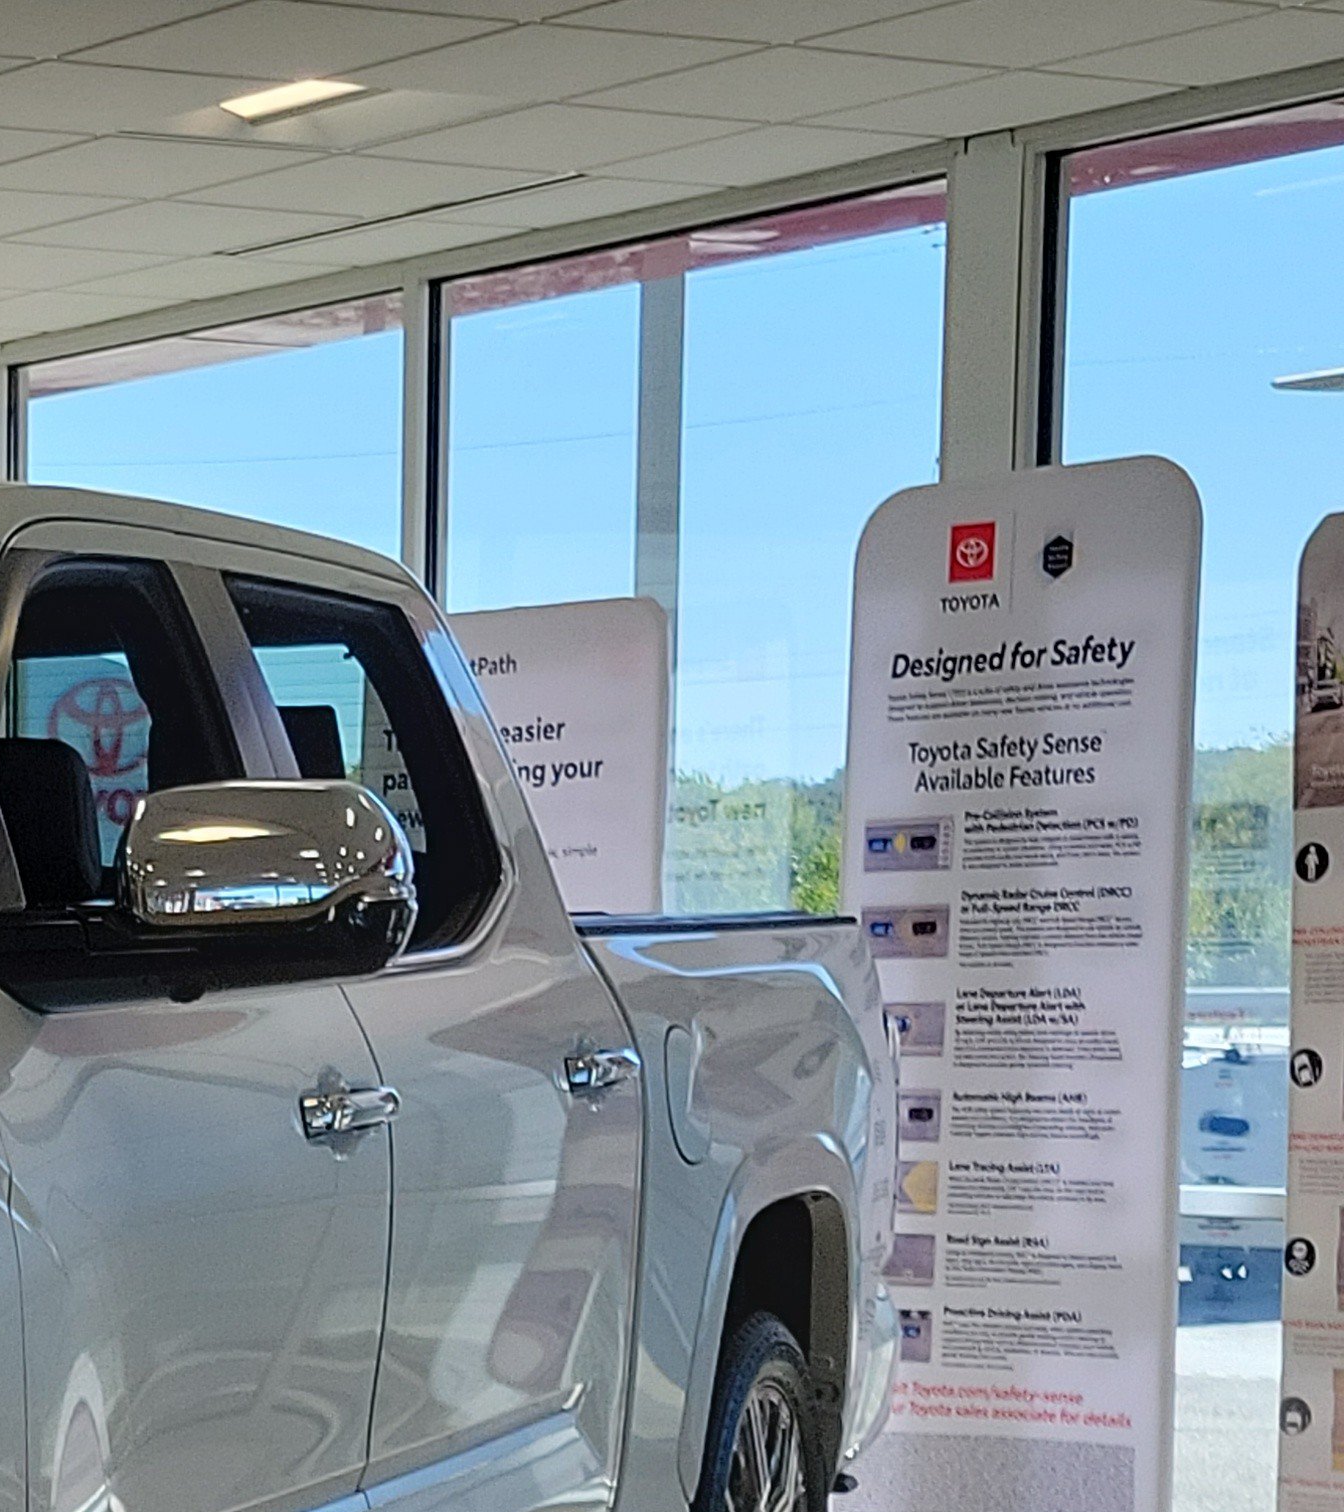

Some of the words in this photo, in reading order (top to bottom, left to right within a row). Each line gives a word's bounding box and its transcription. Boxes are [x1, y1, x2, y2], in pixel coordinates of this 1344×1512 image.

[940, 593, 1000, 613] TOYOTA
[890, 641, 1006, 682] Designed
[1010, 640, 1047, 670] for
[1050, 634, 1135, 669] Safety
[909, 741, 972, 767] Toyota
[976, 734, 1039, 762] Safety
[1042, 733, 1102, 756] Sense
[552, 759, 603, 787] your
[915, 766, 1005, 793] Available
[1009, 765, 1095, 788] Features
